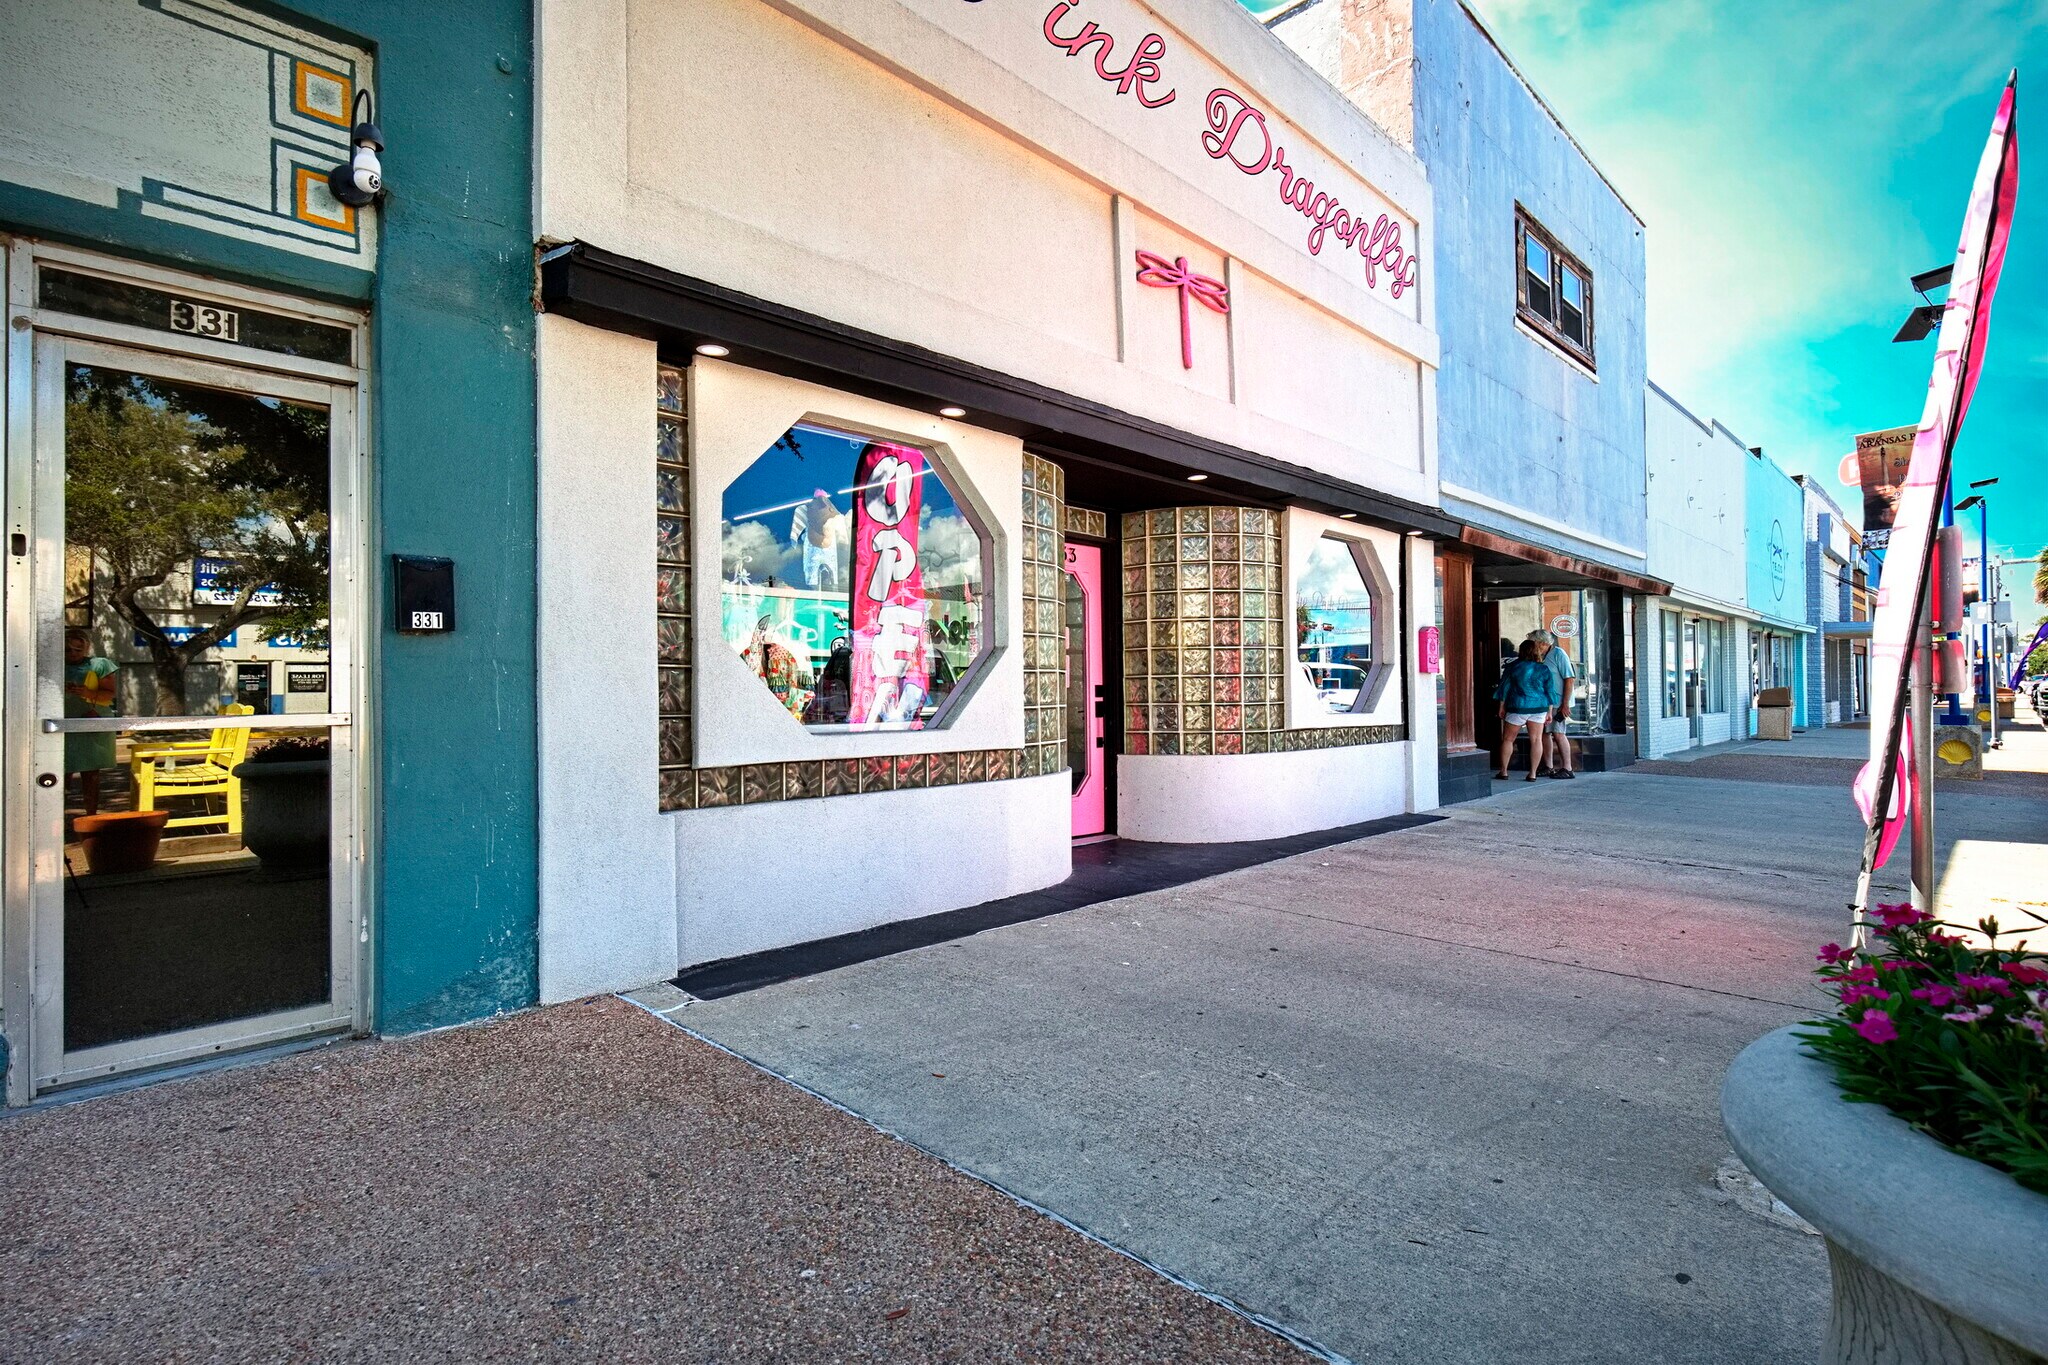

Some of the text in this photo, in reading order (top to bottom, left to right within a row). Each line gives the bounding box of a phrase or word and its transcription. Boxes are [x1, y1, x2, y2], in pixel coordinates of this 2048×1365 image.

[964, 0, 1415, 300] ink Dragonfly
[173, 303, 236, 340] 331
[1859, 434, 1907, 450] ARANSAS
[863, 454, 926, 730] OPEN
[414, 613, 441, 628] 331
